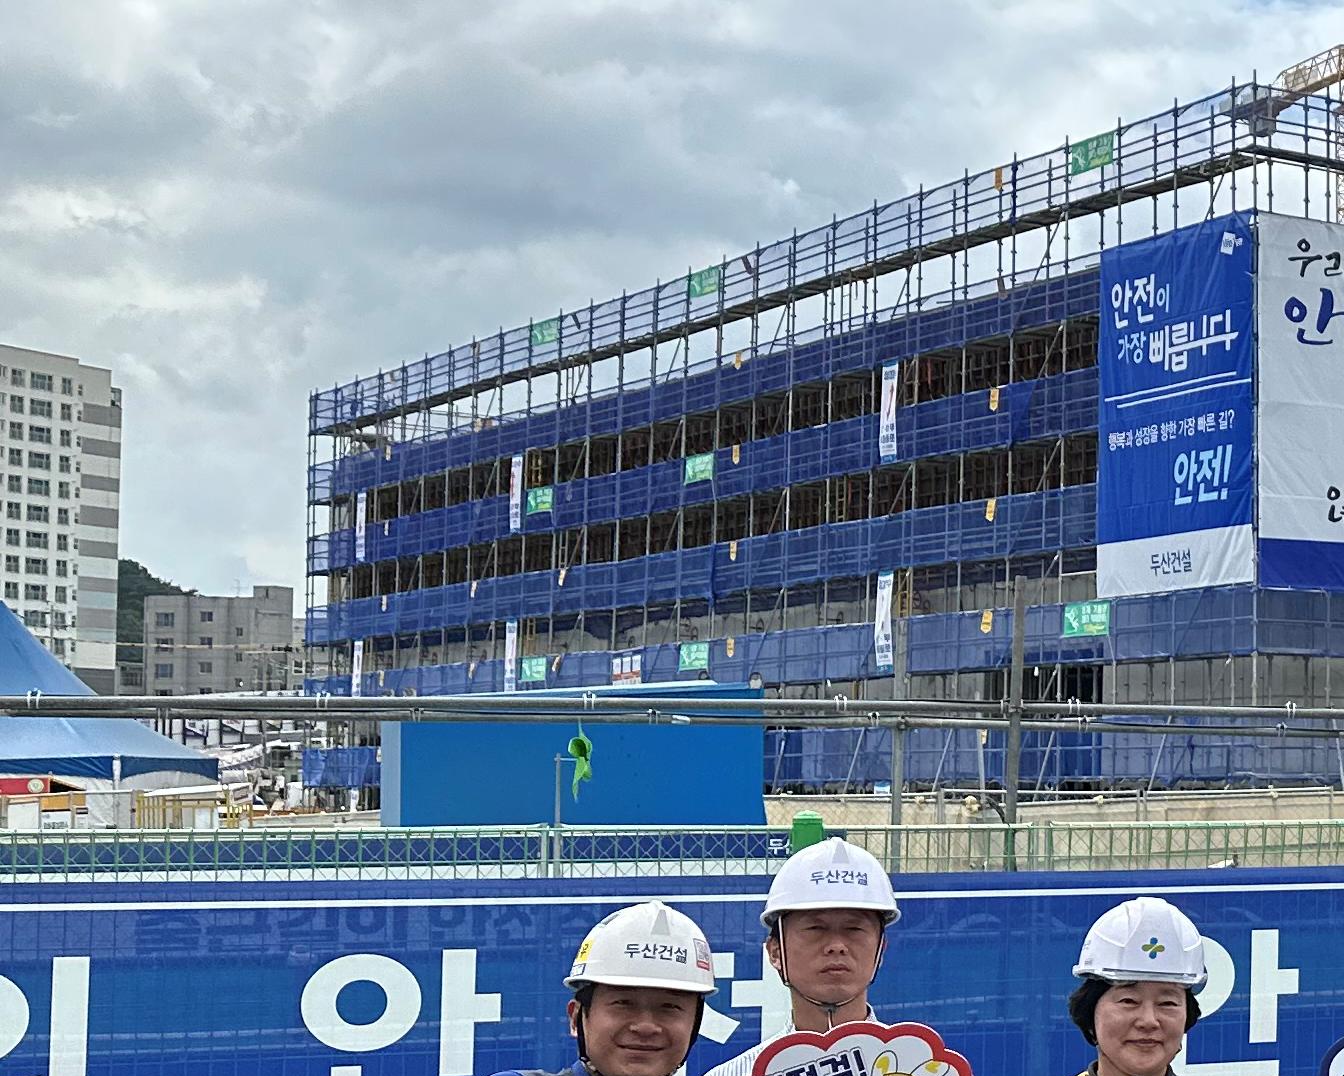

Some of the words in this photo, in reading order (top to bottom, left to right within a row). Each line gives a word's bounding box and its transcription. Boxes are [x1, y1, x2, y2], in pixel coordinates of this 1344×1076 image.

[1111, 273, 1170, 329] 안전이
[1118, 331, 1147, 364] 가장
[1149, 309, 1239, 373] 빠릅니다
[1108, 431, 1134, 452] 행복과
[1135, 424, 1159, 447] 성장을
[1179, 416, 1196, 437] 가장
[1197, 411, 1216, 434] 빠른
[1218, 409, 1235, 431] 길?
[1173, 444, 1233, 506] 안전!
[1150, 548, 1193, 577] 두산건설
[810, 869, 868, 886] 두산건설
[624, 943, 688, 964] 두산건설
